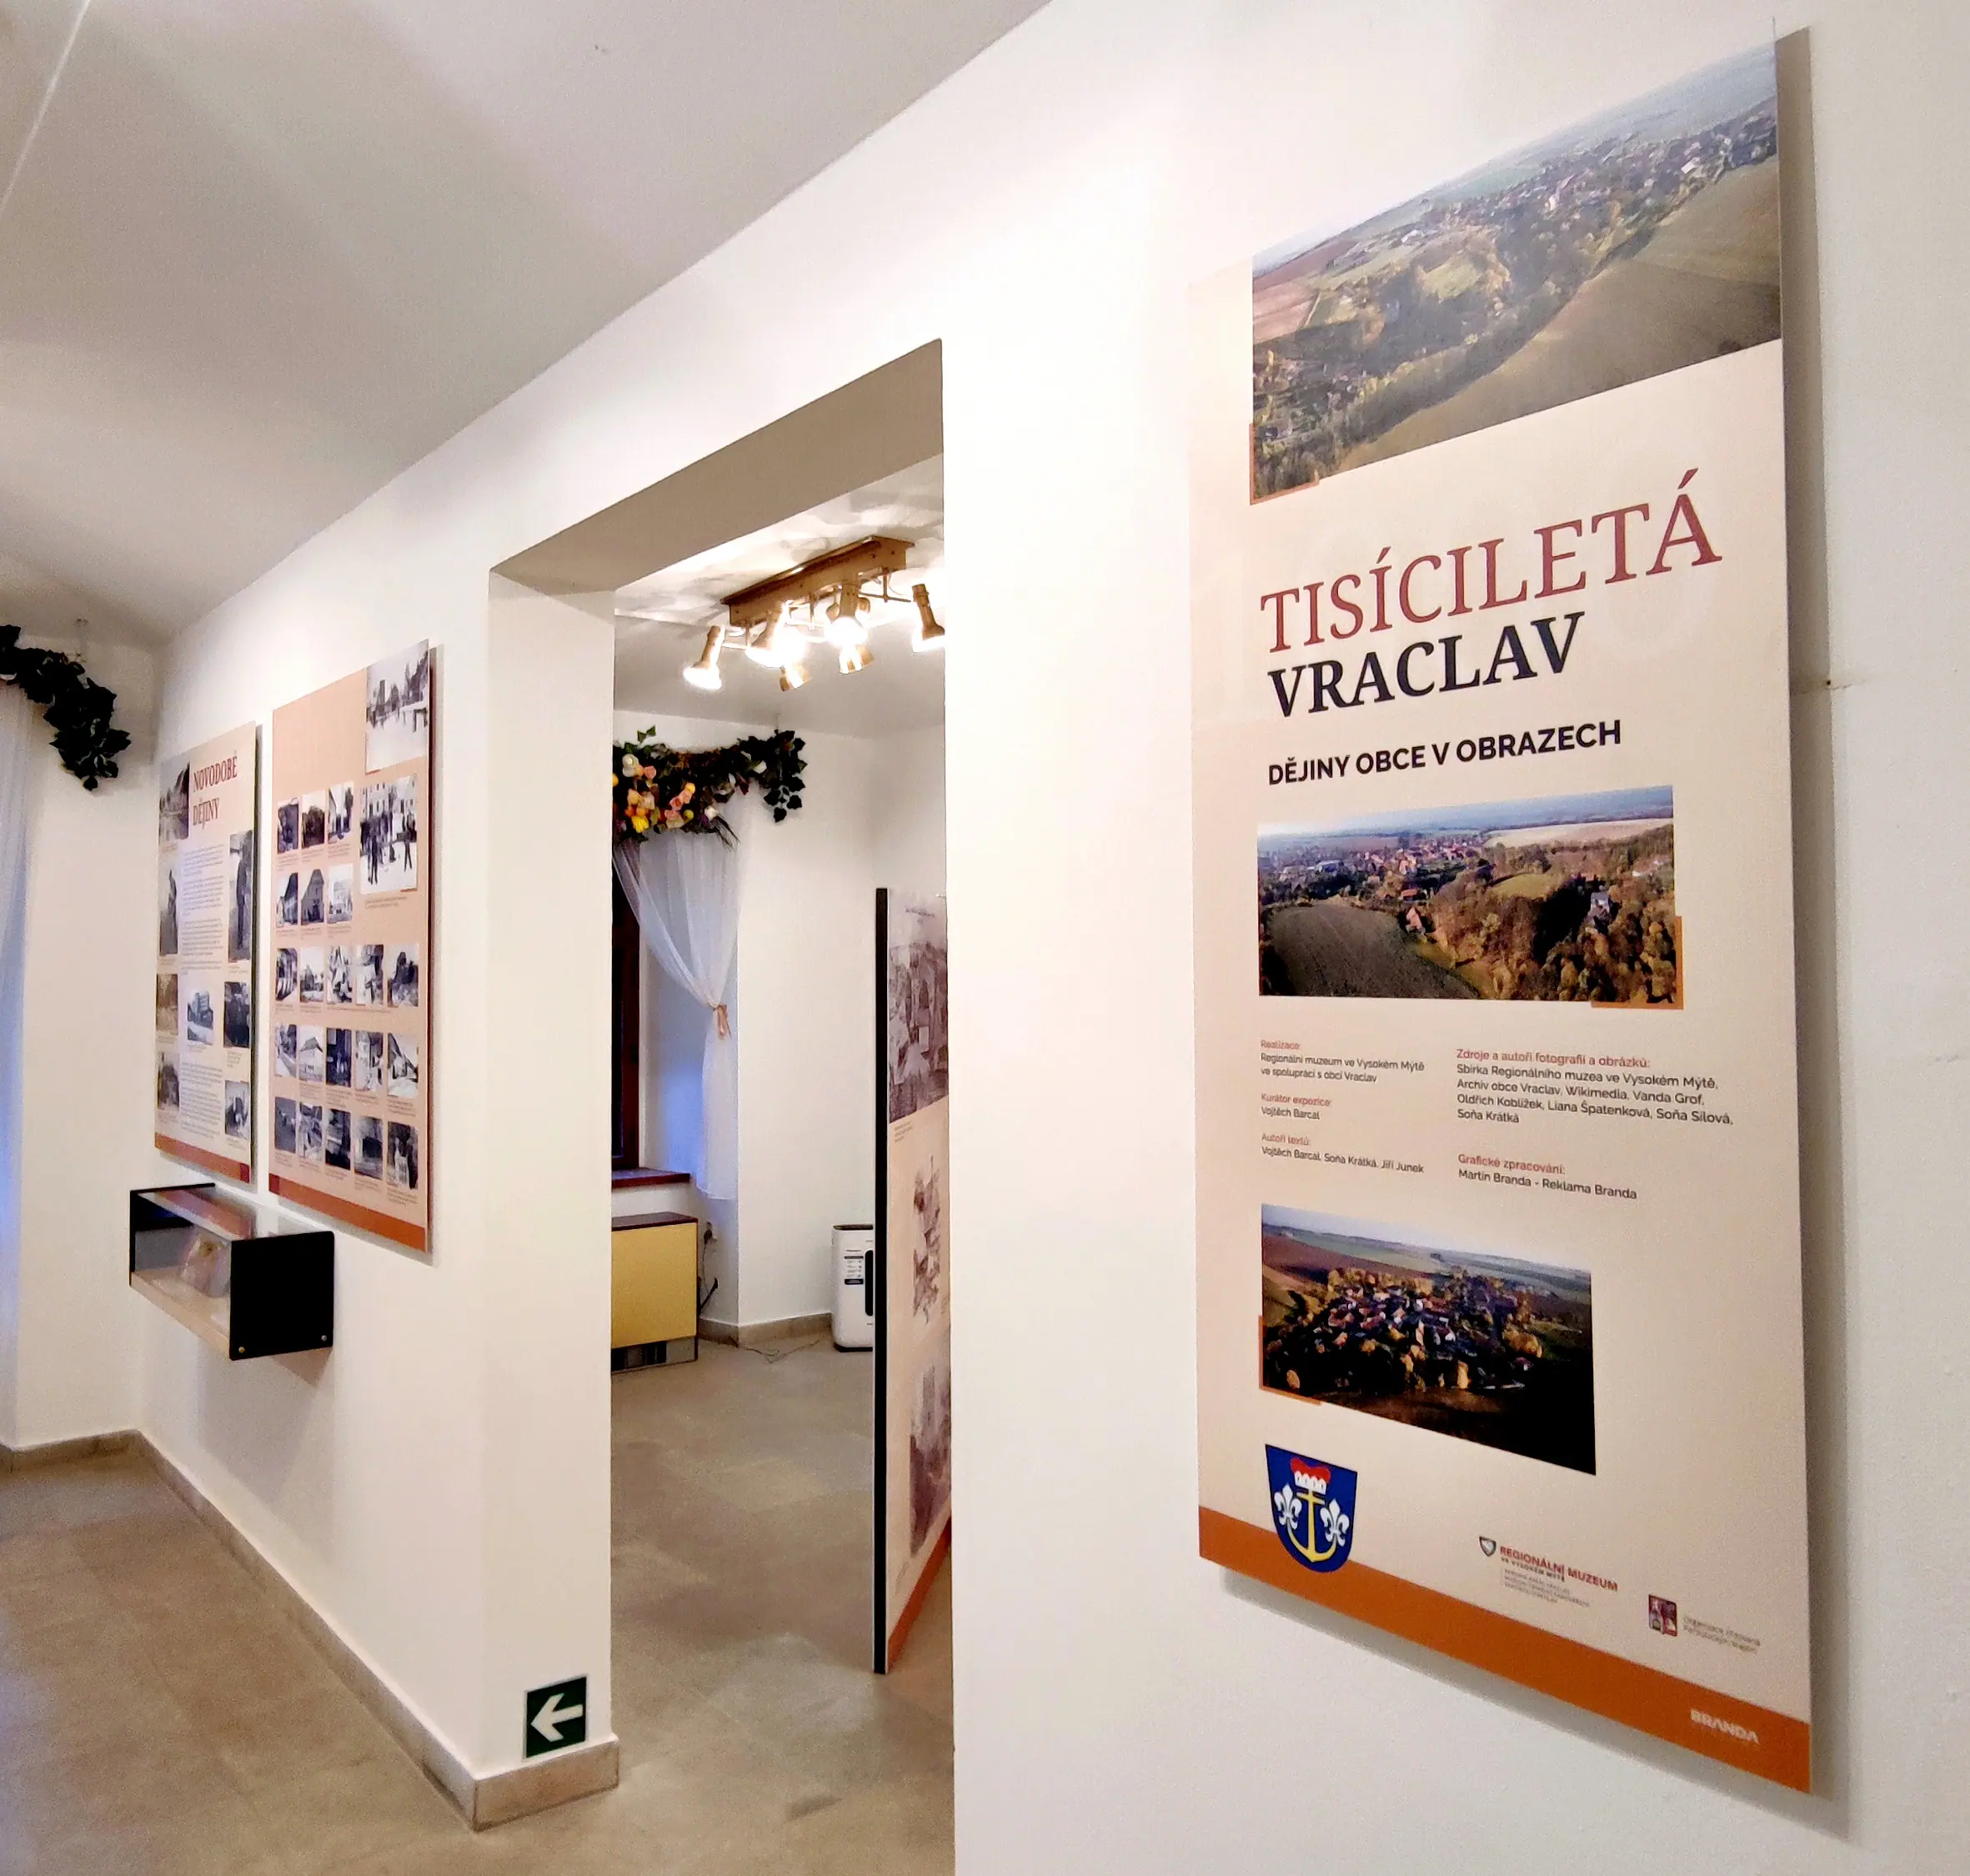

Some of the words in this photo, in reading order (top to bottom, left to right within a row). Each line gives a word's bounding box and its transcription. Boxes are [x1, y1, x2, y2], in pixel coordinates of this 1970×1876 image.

[1261, 468, 1722, 653] TISÍCILETÁ
[1268, 612, 1584, 717] VRACLAV
[1269, 755, 1349, 785] DĚJINY
[1356, 746, 1425, 775] OBCE
[1431, 743, 1449, 765] V
[1456, 720, 1620, 761] OBRAZECH
[193, 750, 237, 792] NOVODOBÉ
[193, 798, 219, 829] DĚJINY
[1306, 1057, 1342, 1066] muzeum
[1357, 1058, 1398, 1070] Vysokém
[1401, 1061, 1424, 1073] Mýtě
[1457, 1049, 1489, 1061] Zdroje
[1501, 1051, 1532, 1061] autoři
[1345, 1072, 1376, 1082] Vraclav
[1491, 1066, 1561, 1078] Regionálního
[1566, 1071, 1602, 1082] muzea
[1607, 1075, 1619, 1083] ve
[1623, 1073, 1679, 1086] Vysokém
[1261, 1093, 1291, 1102] Kurátor
[1457, 1079, 1488, 1090] Archiv
[1491, 1082, 1517, 1091] obce
[1632, 1091, 1671, 1102] Vanda
[1261, 1106, 1291, 1117] Vojtěch
[1294, 1109, 1320, 1120] Barcal
[1457, 1094, 1494, 1106] Oldřich
[1548, 1101, 1577, 1111] Liana
[1657, 1108, 1687, 1121] Soňa
[1457, 1109, 1482, 1120] Soňa
[1486, 1111, 1519, 1123] Krátká
[1261, 1146, 1291, 1157] Vojtěch
[1396, 1162, 1424, 1173] Junek
[1458, 1154, 1500, 1166] Grafické
[1459, 1169, 1491, 1181] Martin
[1494, 1173, 1531, 1186] Branda
[1542, 1179, 1591, 1193] Reklama
[1595, 1185, 1637, 1199] Branda
[1568, 1568, 1617, 1591] MUZEUM
[1691, 1708, 1759, 1744] BRANDA
